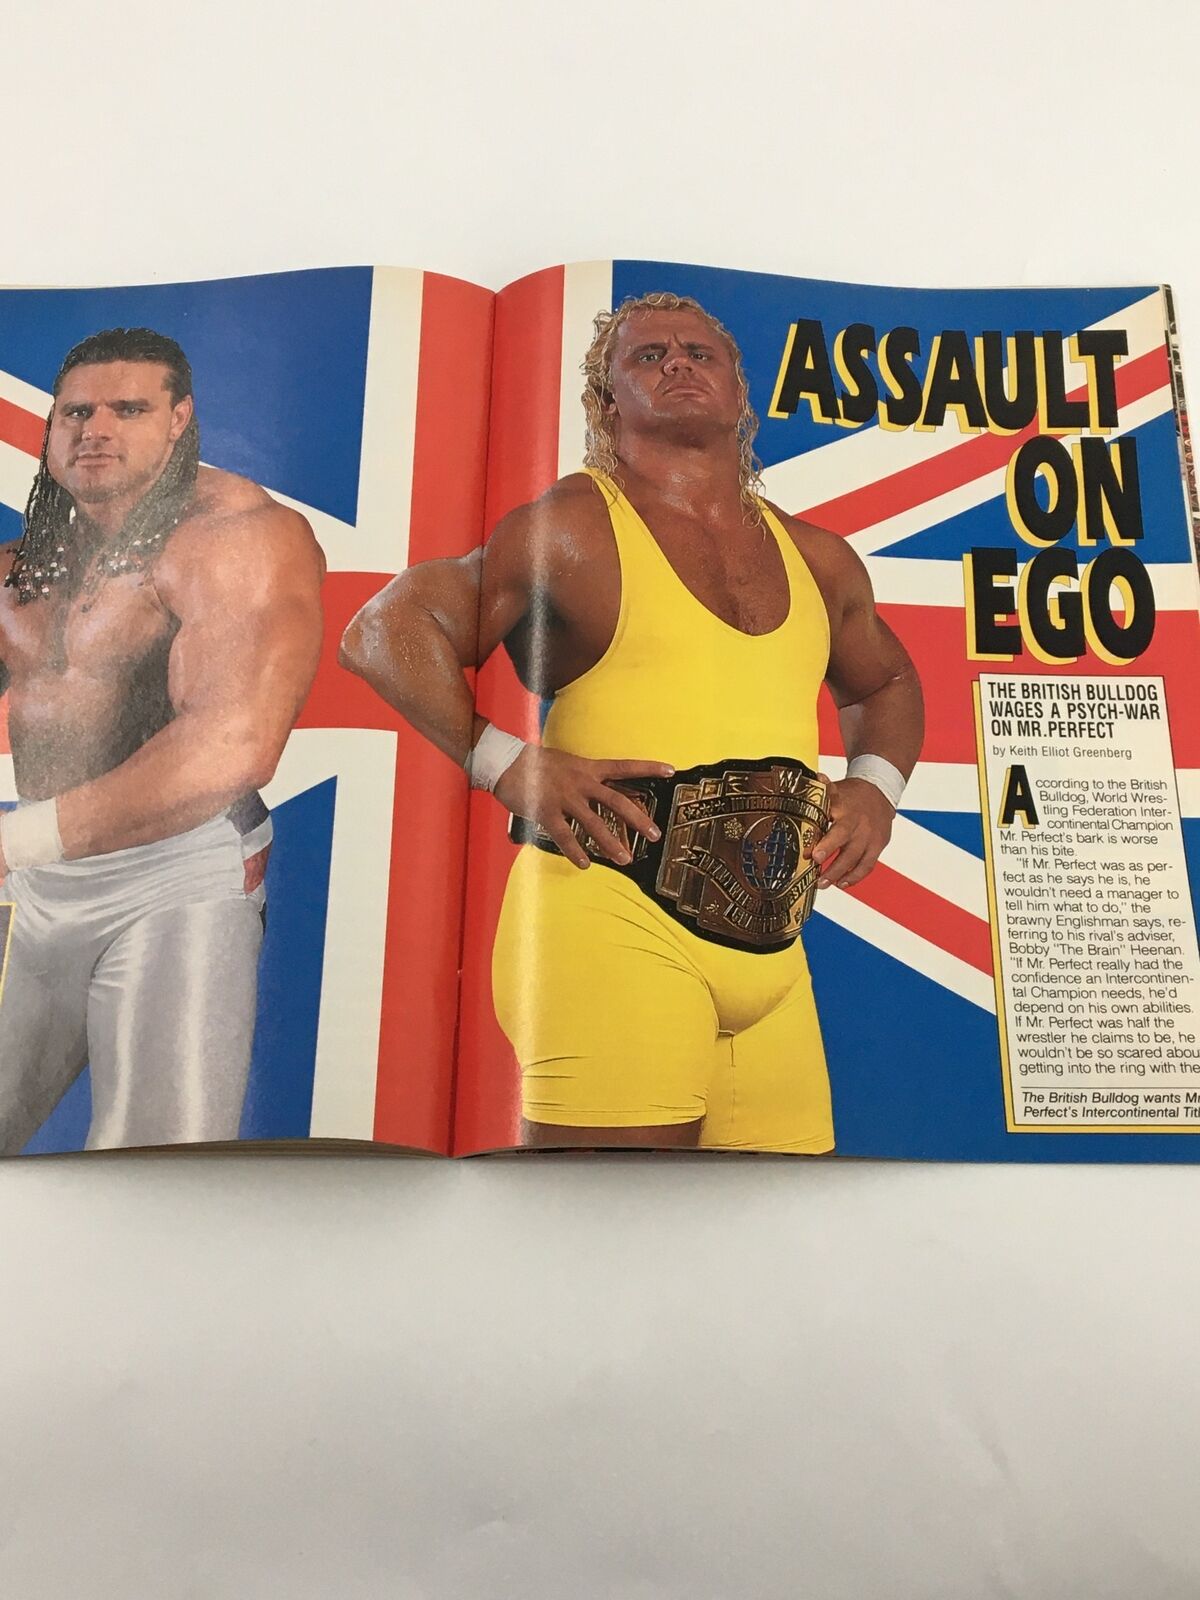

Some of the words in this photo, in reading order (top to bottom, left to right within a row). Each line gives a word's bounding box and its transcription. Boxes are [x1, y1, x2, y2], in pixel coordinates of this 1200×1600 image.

[768, 318, 1128, 435] ASSAULT
[1005, 436, 1144, 547] ON
[963, 547, 1156, 665] EGO
[987, 681, 1017, 699] THE
[1021, 682, 1082, 701] BRITISH
[1085, 684, 1158, 701] BULLDOG
[989, 700, 1044, 719] WAGES
[1050, 702, 1061, 719] A
[1066, 702, 1161, 720] PSYCH-WAR
[991, 719, 1012, 737] ON
[992, 745, 1006, 758] by
[1009, 745, 1038, 756] Keith
[1041, 746, 1070, 757] Elliot
[1073, 746, 1132, 760] Greenberg
[1092, 779, 1105, 790] to
[1107, 779, 1127, 790] the
[1130, 779, 1168, 790] British
[1039, 790, 1089, 805] Bulldog,
[1092, 792, 1128, 803] World
[1130, 792, 1168, 804] Wres-
[1043, 804, 1069, 818] tling
[1072, 804, 1137, 817] Federation
[1140, 806, 1172, 817] Inter-
[1047, 818, 1110, 830] continental
[1111, 818, 1174, 833] Champion
[1000, 830, 1017, 841] Mr.
[1021, 830, 1073, 843] Perfect's
[1076, 832, 1104, 844] bark
[1107, 833, 1118, 844] is
[1120, 835, 1158, 845] worse
[1000, 843, 1027, 855] than
[1030, 844, 1049, 856] his
[1052, 845, 1078, 857] bite.
[1032, 858, 1050, 869] Mr.
[1054, 858, 1097, 871] Perfect
[1100, 862, 1126, 871] was
[1128, 862, 1144, 871] as
[1147, 862, 1173, 874] per-
[1002, 871, 1026, 883] fect
[1029, 874, 1044, 883] as
[1047, 872, 1063, 884] he
[1066, 875, 1095, 887] says
[1098, 873, 1114, 885] he
[1118, 874, 1131, 886] is,
[1134, 874, 1151, 886] he
[1004, 886, 1056, 898] wouldn't
[1059, 887, 1092, 899] need
[1095, 889, 1104, 899] a
[1107, 890, 1163, 902] manager
[1166, 889, 1179, 900] to
[1005, 899, 1023, 911] tell
[1026, 900, 1050, 911] him
[1053, 901, 1083, 913] what
[1086, 902, 1099, 913] to
[1130, 902, 1151, 914] the
[1006, 913, 1052, 929] brawny
[1056, 914, 1129, 930] Englishman
[1132, 915, 1165, 930] says,
[1168, 918, 1186, 927] re-
[1007, 927, 1048, 943] ferring
[1051, 929, 1064, 941] to
[1067, 929, 1086, 941] his
[1089, 930, 1124, 942] rival's
[1127, 930, 1175, 943] adviser,
[1009, 941, 1050, 958] Bobby
[1130, 944, 1184, 956] Heenan.
[1027, 957, 1045, 969] Mr.
[1049, 957, 1093, 970] Perfect
[1096, 959, 1131, 973] really
[1134, 958, 1159, 970] had
[1162, 958, 1183, 970] the
[1011, 971, 1082, 984] confidence
[1086, 975, 1102, 984] an
[1105, 972, 1194, 985] Intercontinen-
[1012, 986, 1027, 998] tal
[1030, 985, 1097, 1001] Champion
[1101, 987, 1145, 1000] needs,
[1148, 987, 1178, 999] he'd
[1013, 1001, 1064, 1015] depend
[1067, 1004, 1085, 1014] on
[1088, 1002, 1108, 1014] his
[1111, 1004, 1139, 1014] own
[1142, 1001, 1194, 1014] abilities.
[1015, 1015, 1022, 1027] If
[1026, 1016, 1044, 1028] Mr.
[1048, 1016, 1094, 1029] Perfect
[1096, 1019, 1124, 1029] was
[1127, 1016, 1150, 1028] half
[1153, 1016, 1175, 1029] the
[1016, 1031, 1066, 1044] wrestler
[1070, 1032, 1088, 1044] he
[1091, 1032, 1134, 1044] claims
[1137, 1032, 1150, 1044] to
[1153, 1031, 1175, 1045] be,
[1178, 1031, 1196, 1044] he
[1017, 1046, 1072, 1059] wouldn't
[1076, 1047, 1093, 1059] be
[1097, 1049, 1113, 1059] so
[1117, 1046, 1163, 1059] scared
[1166, 1046, 1200, 1059] abou
[1019, 1061, 1064, 1077] getting
[1067, 1062, 1092, 1074] into
[1094, 1062, 1116, 1074] the
[1120, 1061, 1146, 1077] ring
[1149, 1061, 1176, 1074] with
[1022, 1091, 1045, 1103] The
[1049, 1092, 1088, 1104] British
[1091, 1092, 1139, 1107] Bulldog
[1143, 1093, 1181, 1104] wants
[1023, 1106, 1078, 1118] Perfect's
[1082, 1106, 1180, 1118] Intercontinental
